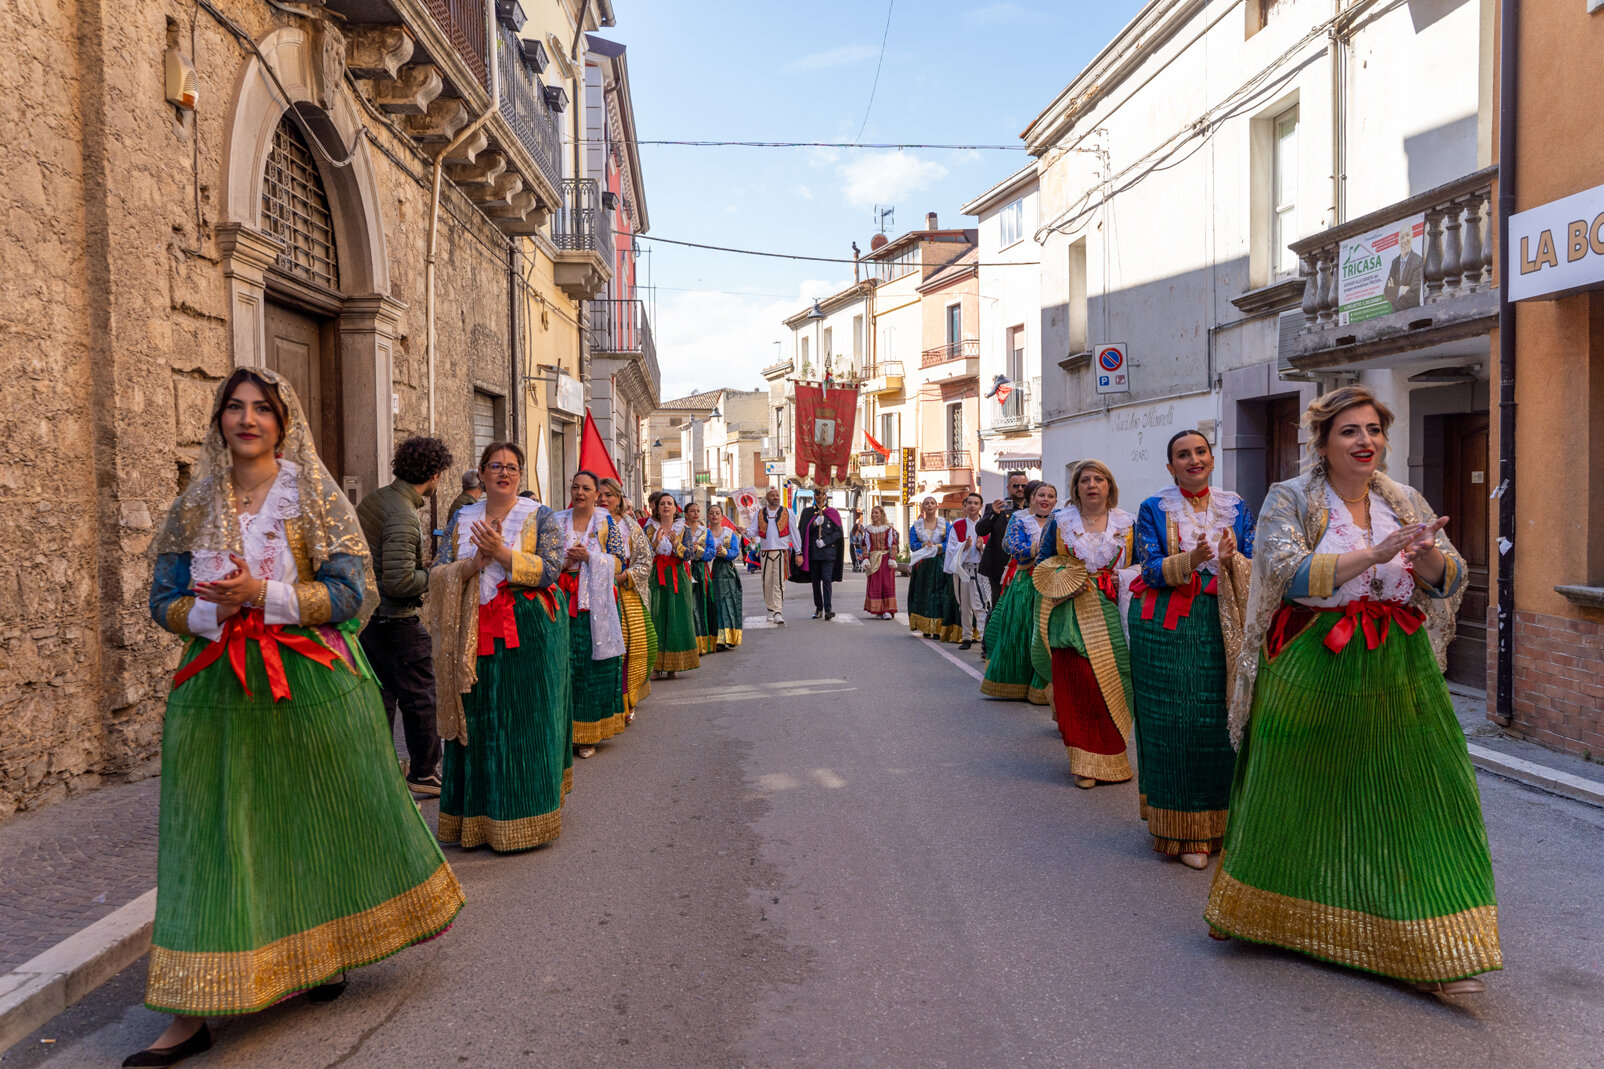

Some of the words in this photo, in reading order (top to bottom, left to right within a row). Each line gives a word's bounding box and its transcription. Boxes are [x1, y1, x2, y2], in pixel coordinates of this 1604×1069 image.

[1520, 229, 1558, 276] LA
[1342, 255, 1382, 278] TRICASA
[1101, 376, 1108, 385] P
